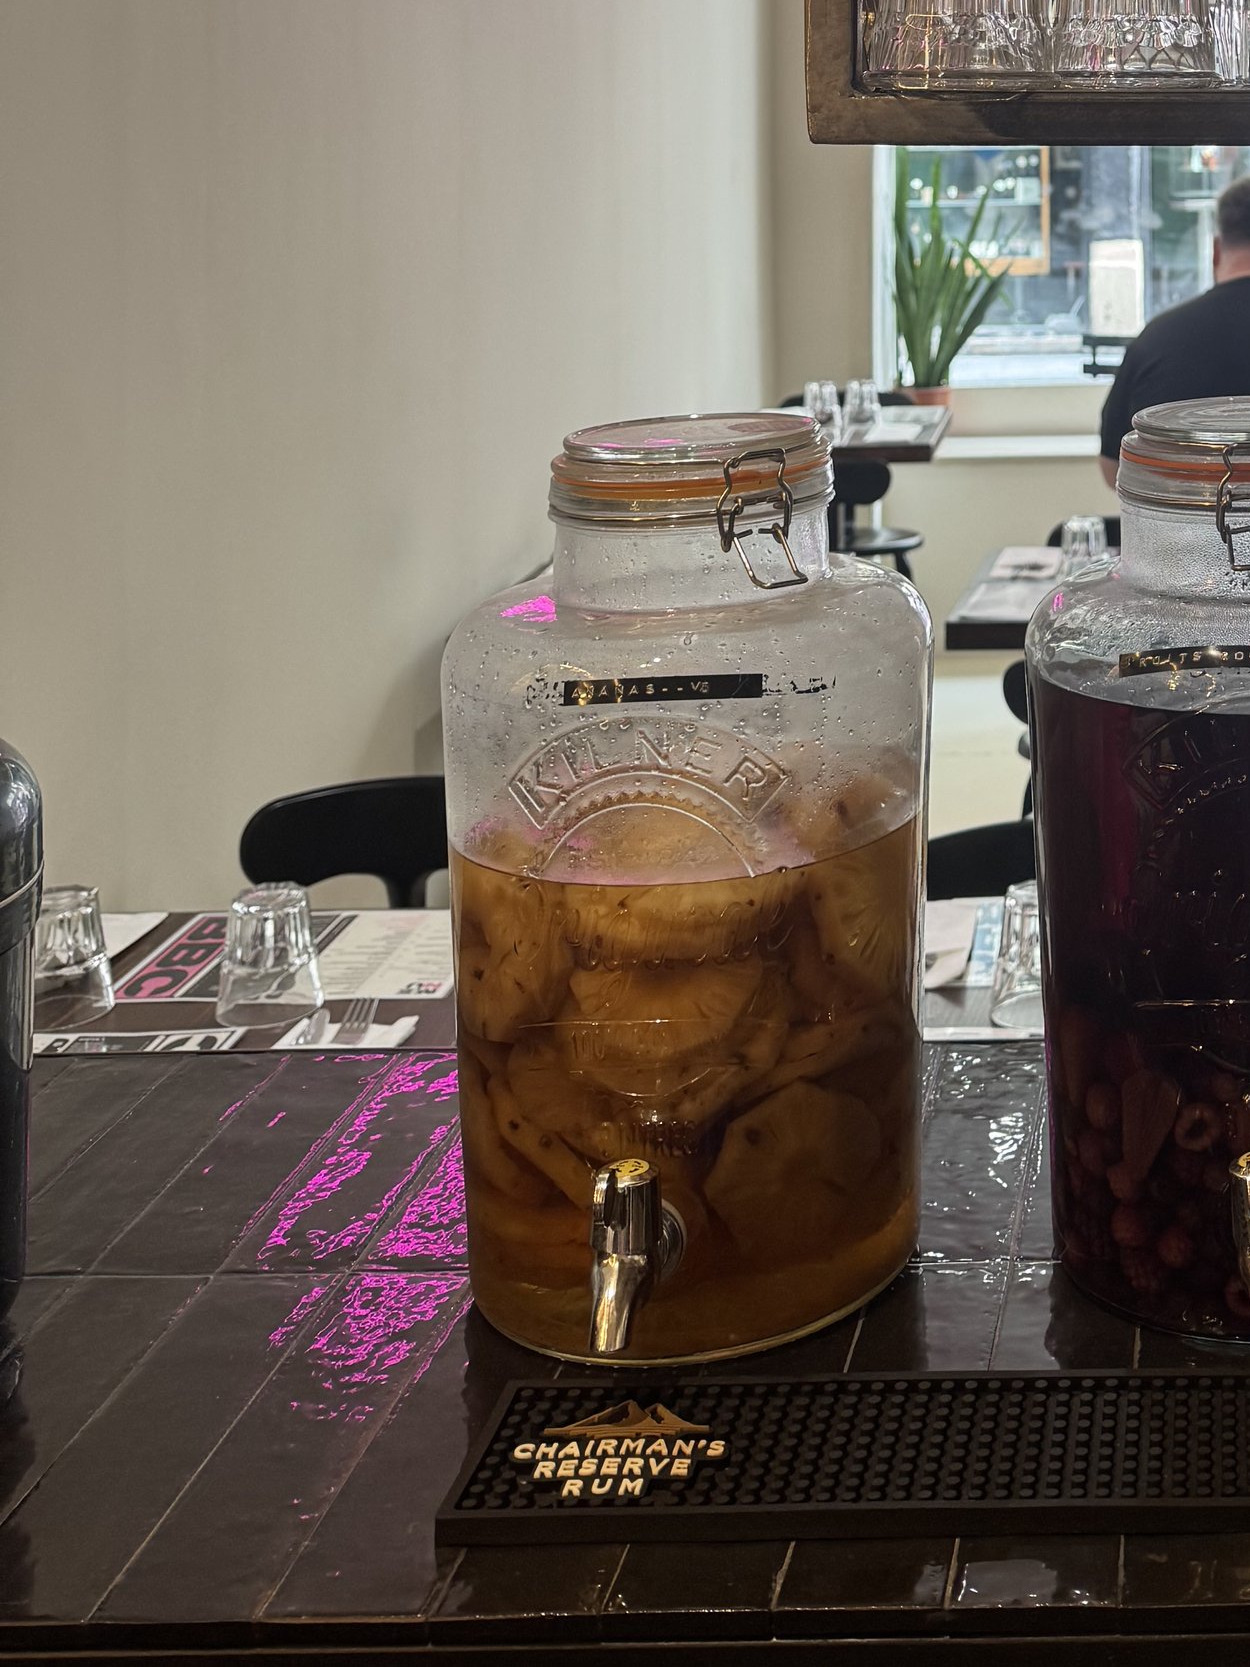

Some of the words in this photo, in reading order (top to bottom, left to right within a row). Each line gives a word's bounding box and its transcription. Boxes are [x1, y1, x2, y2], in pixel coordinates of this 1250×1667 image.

[514, 728, 770, 817] KILNER
[511, 1437, 727, 1461] CHAIRMAN'S
[533, 1456, 691, 1480] RESERVE
[561, 1477, 645, 1498] RUM
